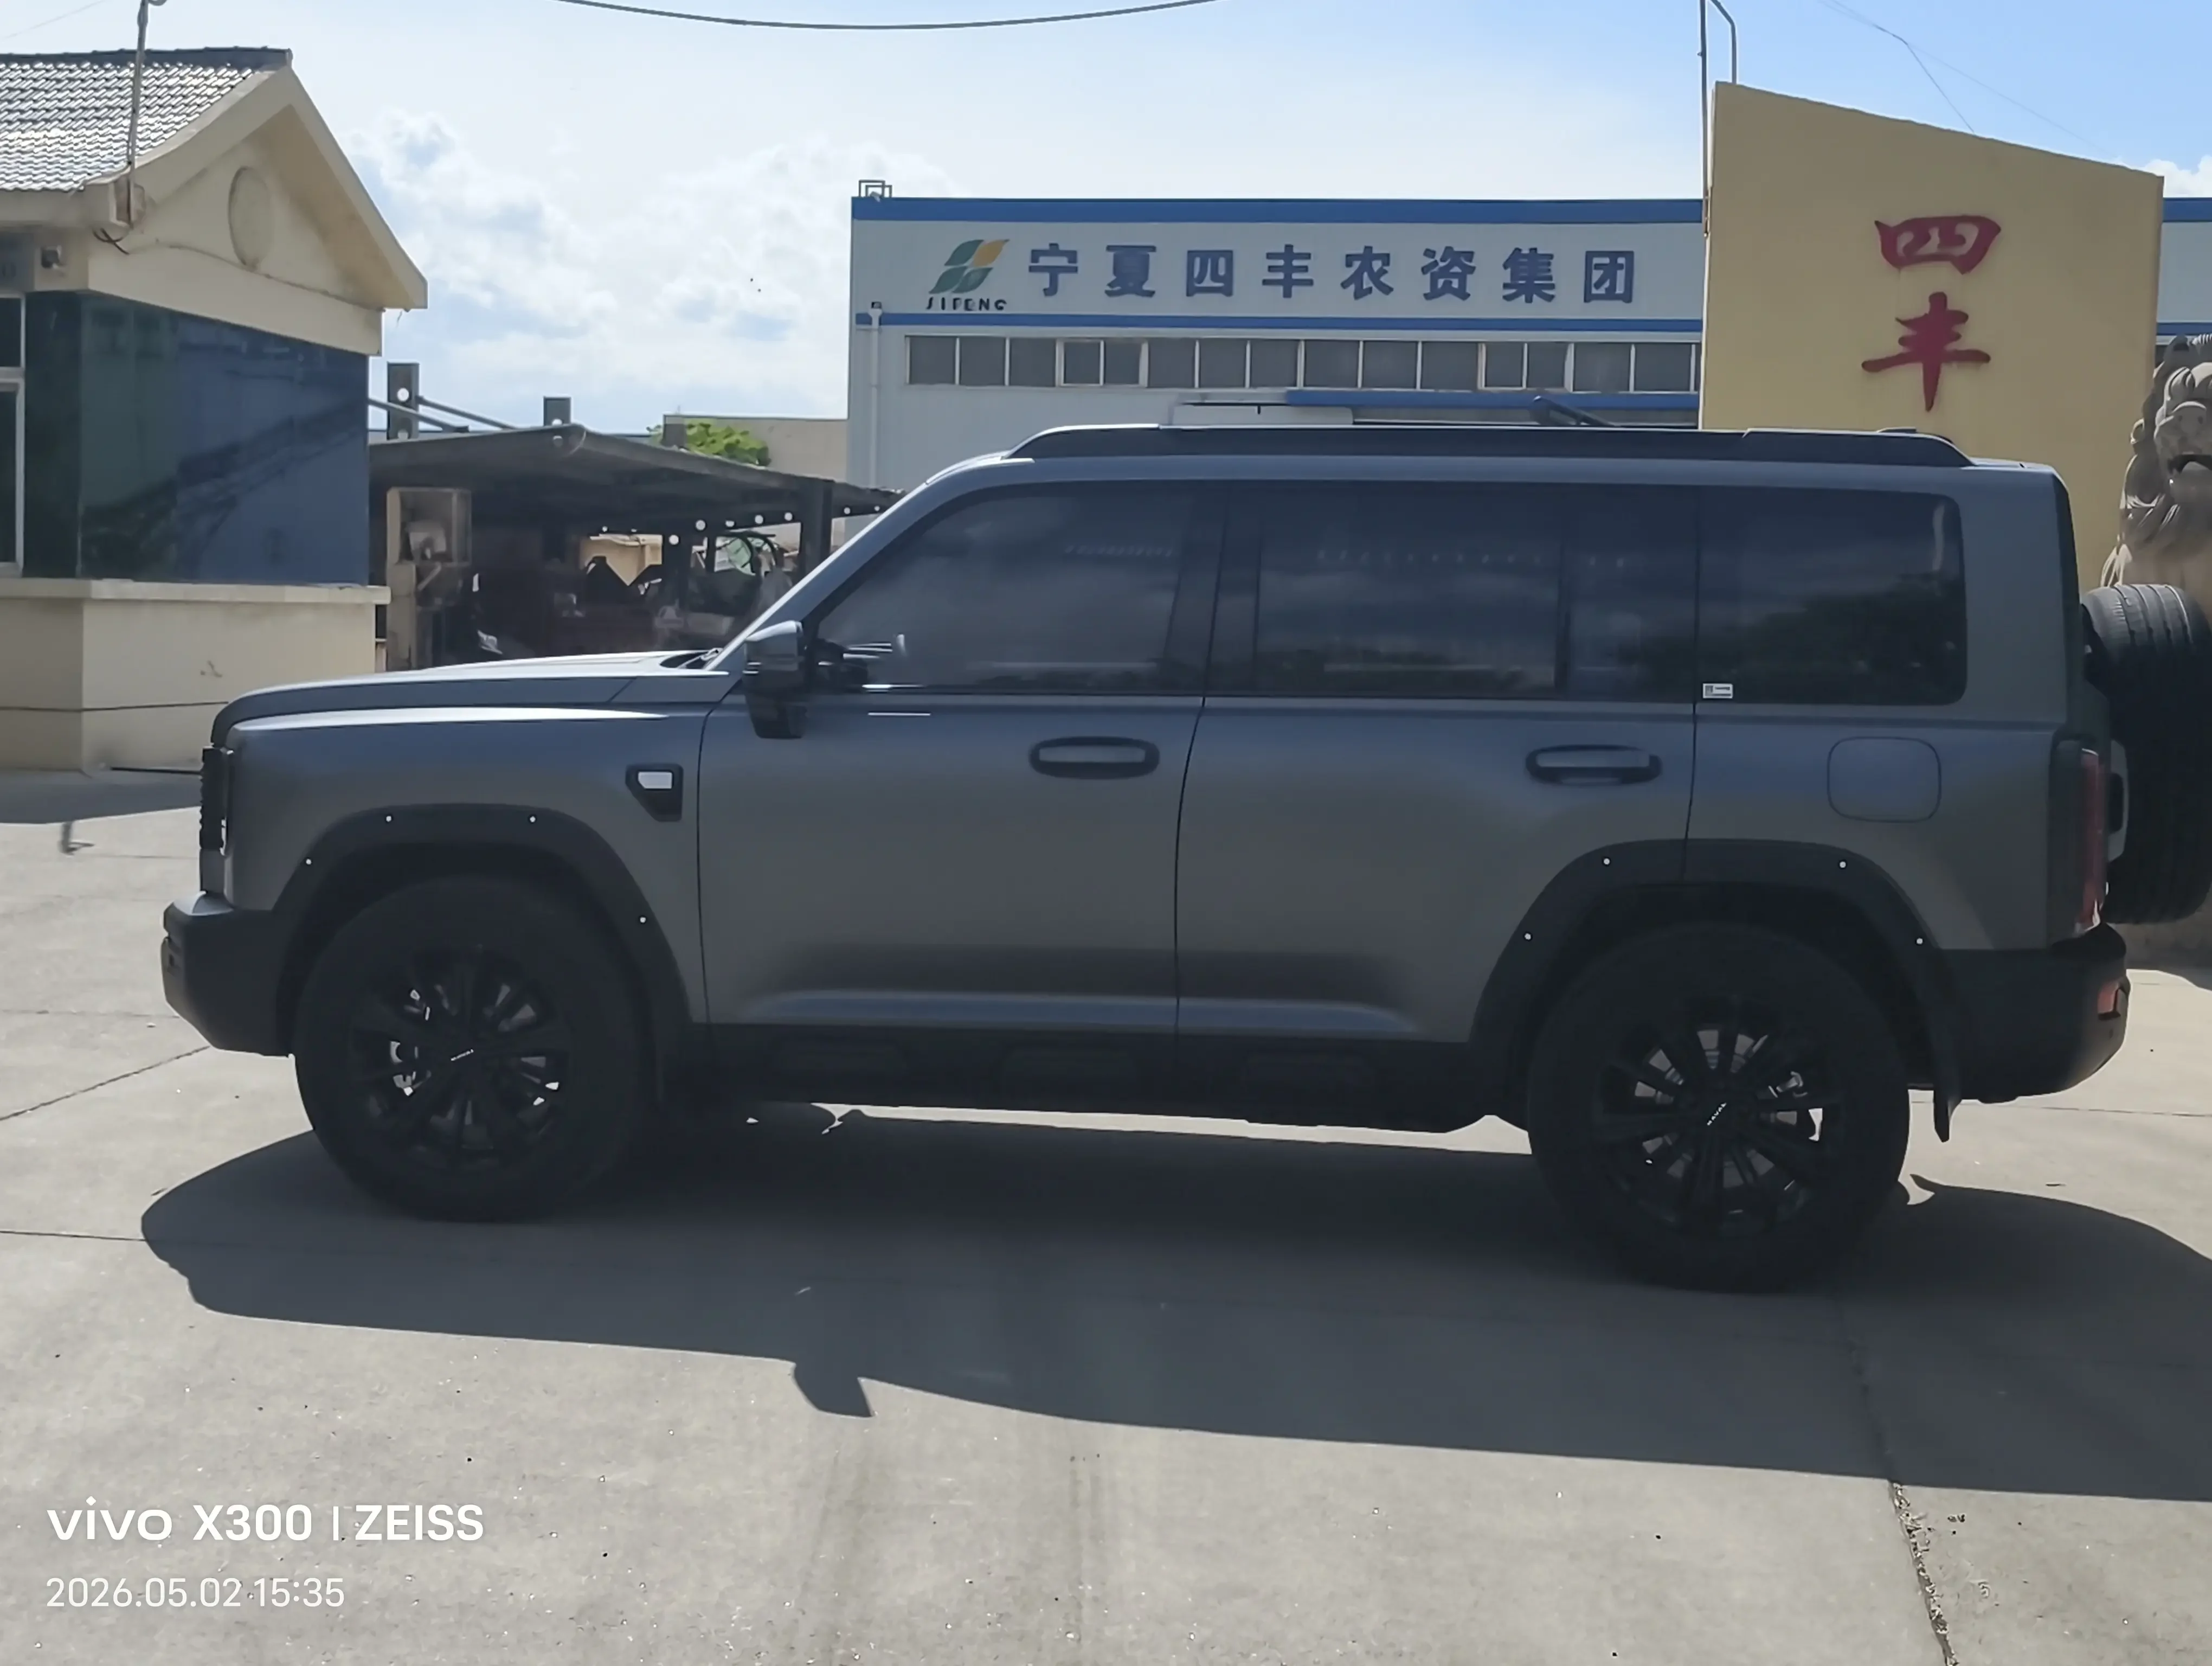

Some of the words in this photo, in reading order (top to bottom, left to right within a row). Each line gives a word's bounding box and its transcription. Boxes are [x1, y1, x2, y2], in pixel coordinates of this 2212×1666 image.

[1027, 242, 1636, 305] 宁夏四丰农资集团
[1861, 215, 2002, 412] 四丰
